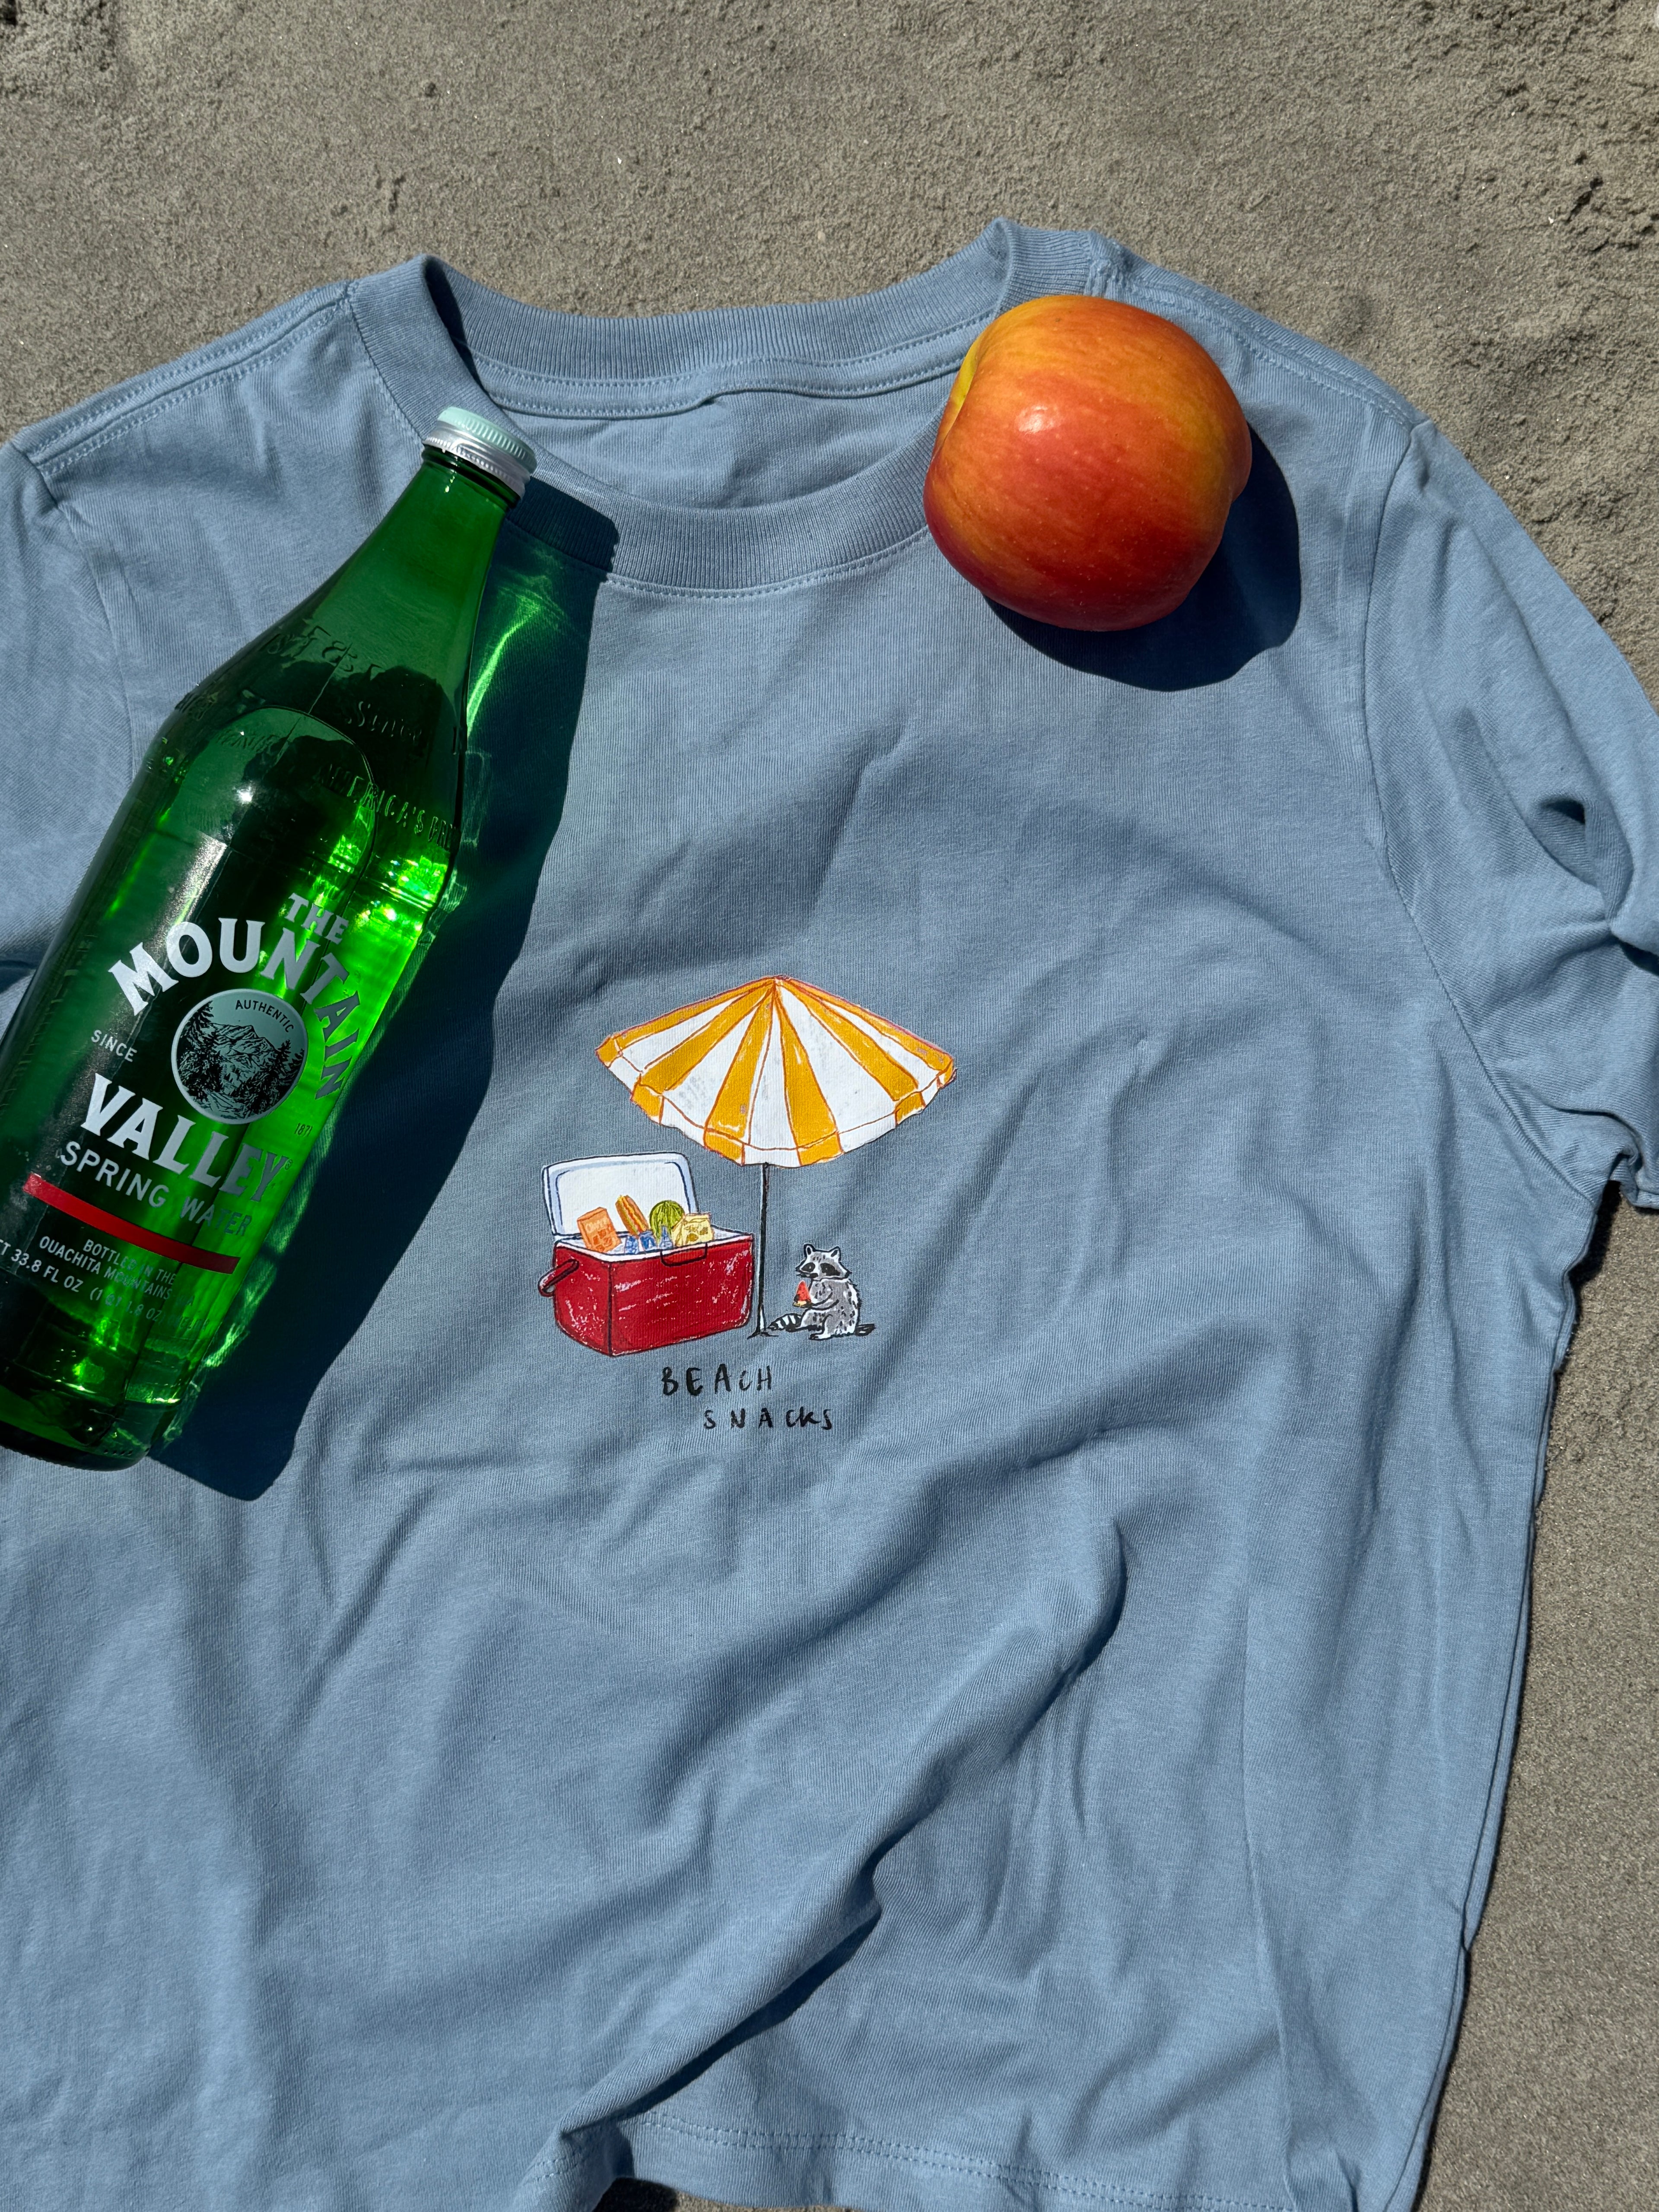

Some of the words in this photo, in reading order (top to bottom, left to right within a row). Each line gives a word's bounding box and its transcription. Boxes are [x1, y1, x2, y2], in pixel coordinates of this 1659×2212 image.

[284, 893, 349, 945] THE
[108, 918, 360, 1100] MOUNTAIN
[235, 1000, 294, 1033] AUTHENTIC
[91, 1030, 137, 1062] SINCE
[294, 1122, 313, 1137] 1871
[60, 1141, 169, 1208] SPRING
[180, 1196, 252, 1236] WATER
[11, 1249, 42, 1272] 33.8
[43, 1265, 59, 1283] FL
[64, 1275, 84, 1292] OZ
[125, 1301, 144, 1316] 1.8
[39, 1236, 101, 1274] OUACHITA
[104, 1266, 172, 1300] MOUNTAINS
[83, 1239, 137, 1271] BOTTLED
[138, 1264, 153, 1277] IN
[156, 1269, 176, 1285] THE
[661, 1363, 772, 1396] BEACH
